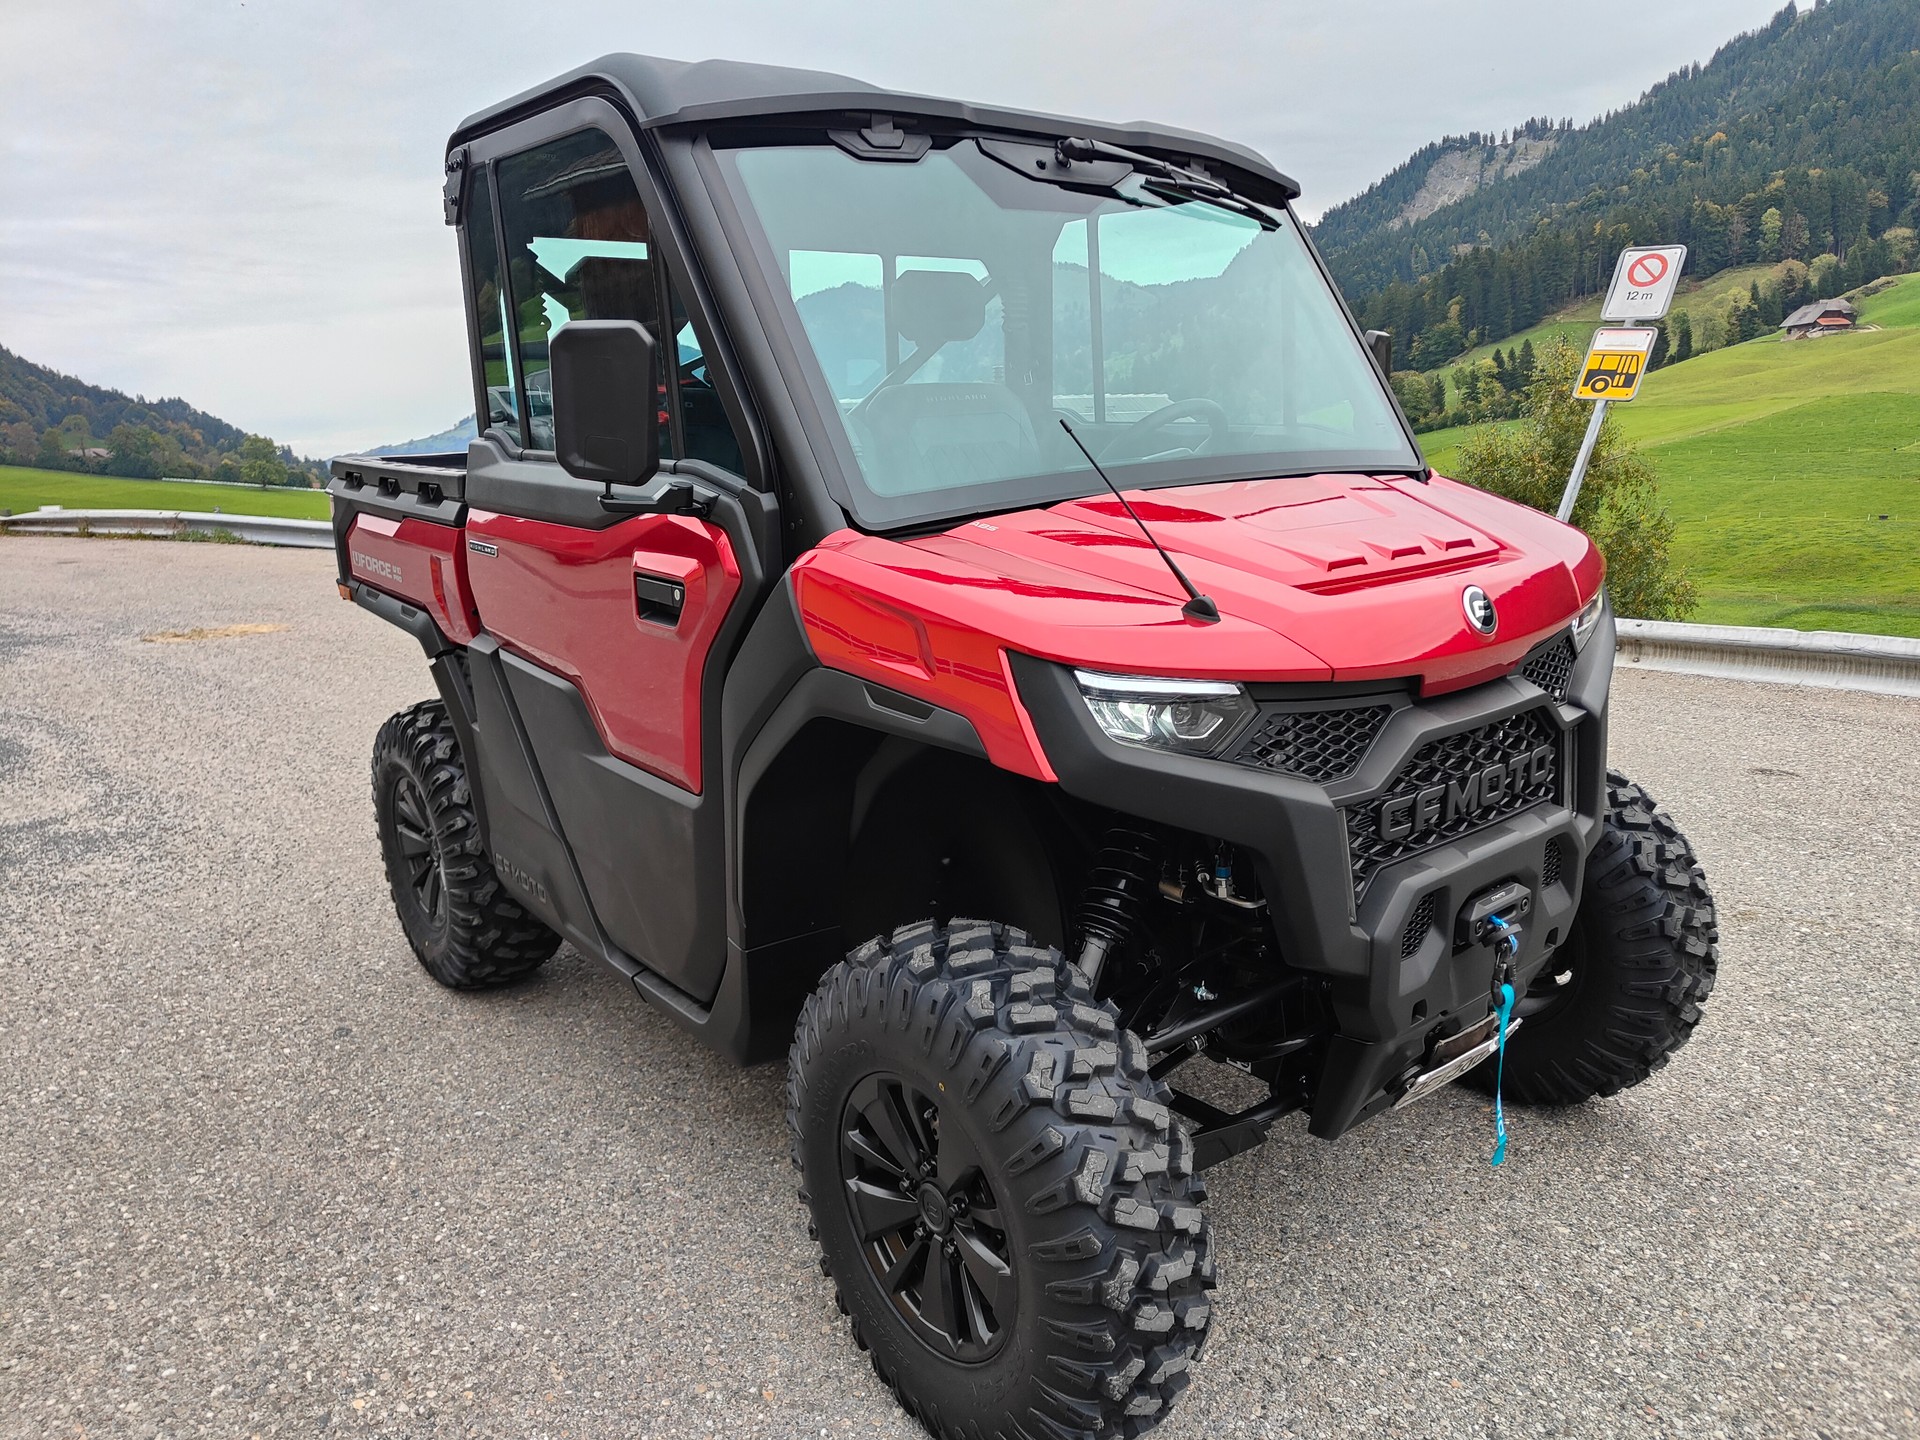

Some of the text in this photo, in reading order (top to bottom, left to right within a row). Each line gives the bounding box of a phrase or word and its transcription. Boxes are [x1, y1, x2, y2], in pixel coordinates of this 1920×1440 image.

[1626, 290, 1653, 301] 12 m
[1380, 744, 1550, 841] CFMOTO
